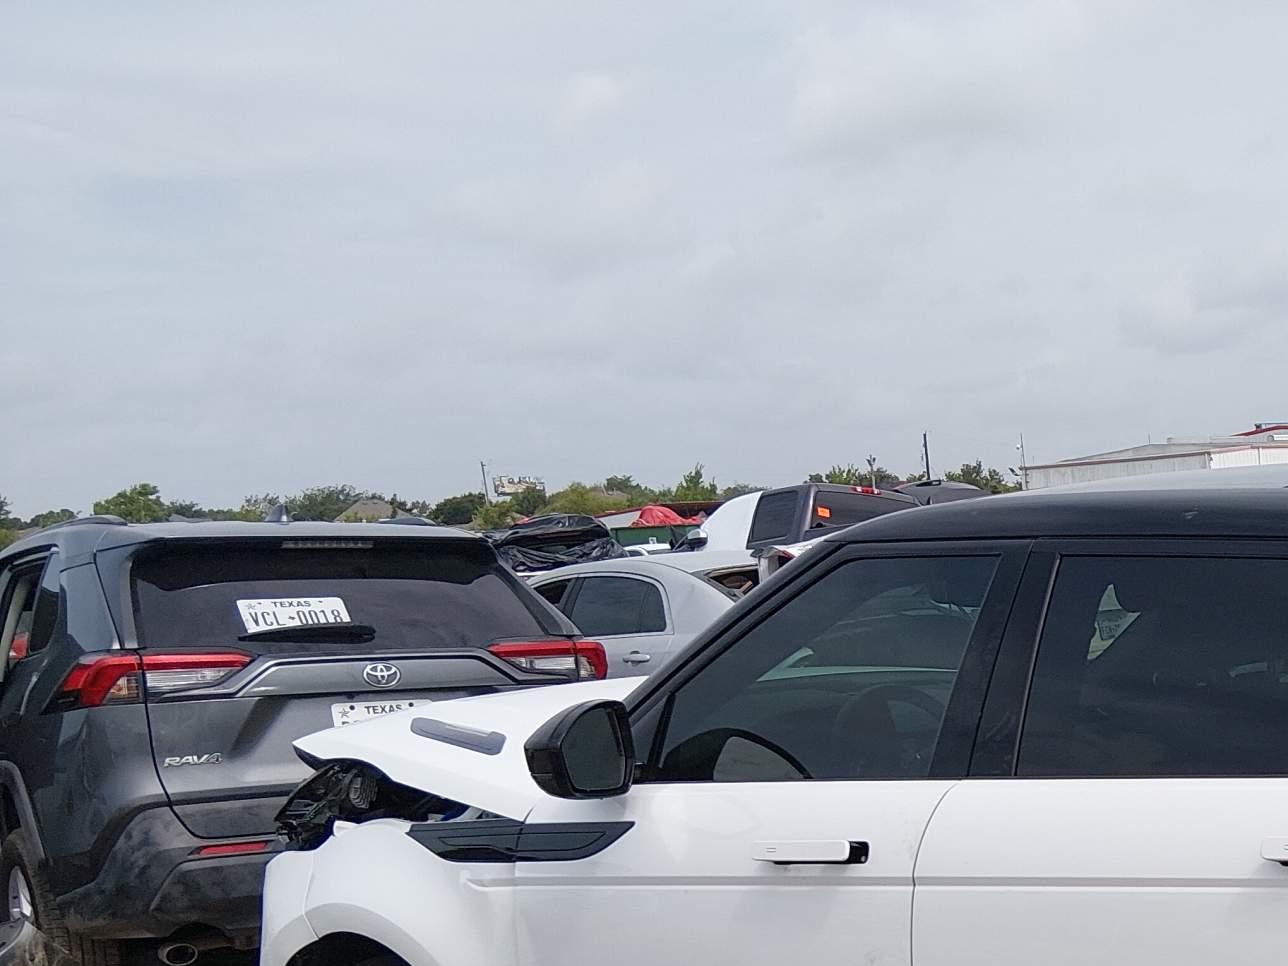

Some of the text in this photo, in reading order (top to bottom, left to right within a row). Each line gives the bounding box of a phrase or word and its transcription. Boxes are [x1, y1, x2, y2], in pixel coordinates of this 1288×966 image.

[272, 600, 311, 608] TEXAS
[248, 609, 343, 627] VCL 0018
[364, 704, 403, 714] TEXAS
[164, 752, 222, 767] RAV4
